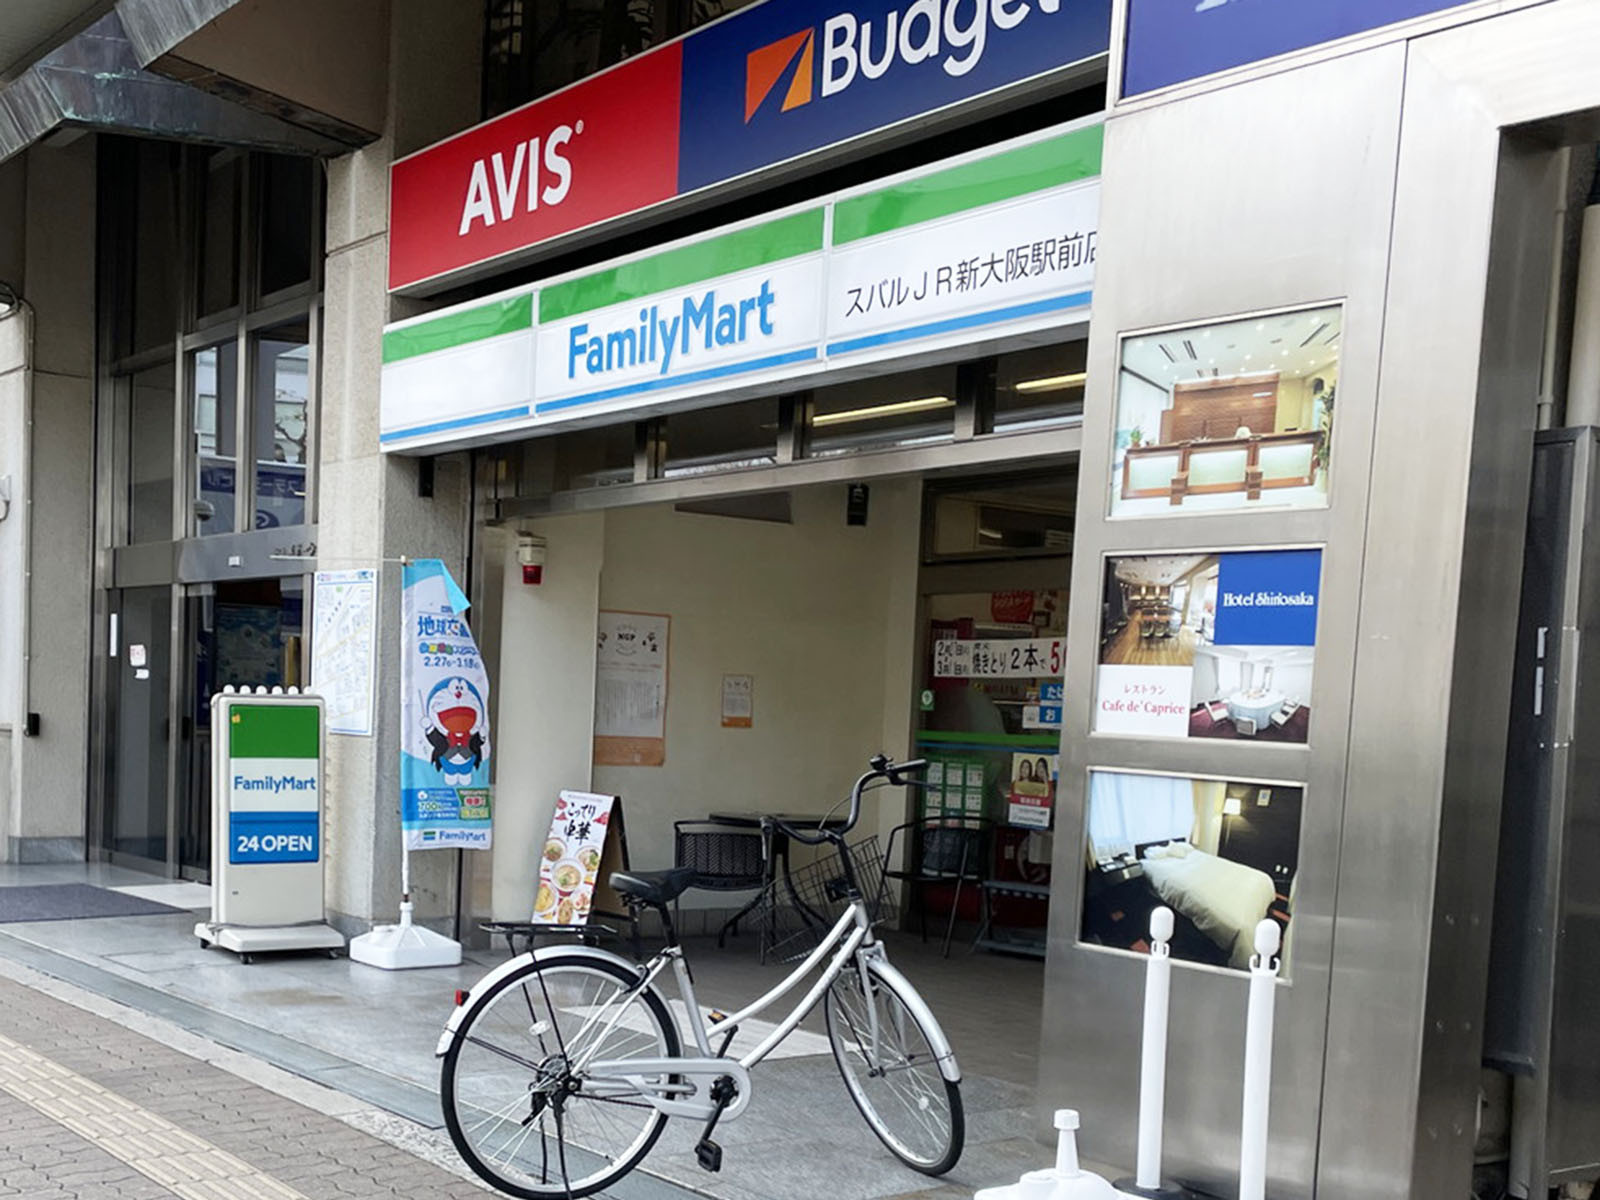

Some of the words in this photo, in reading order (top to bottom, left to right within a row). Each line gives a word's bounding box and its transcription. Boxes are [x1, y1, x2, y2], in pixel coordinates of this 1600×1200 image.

[458, 124, 573, 236] AVIS
[568, 279, 775, 379] FamilyMart
[1223, 592, 1254, 607] Hotel
[1050, 641, 1066, 674] 5
[1124, 683, 1166, 695] レストラン
[1102, 700, 1125, 712] Cafe
[1144, 701, 1185, 716] Caprice
[234, 776, 316, 793] FamilyMart
